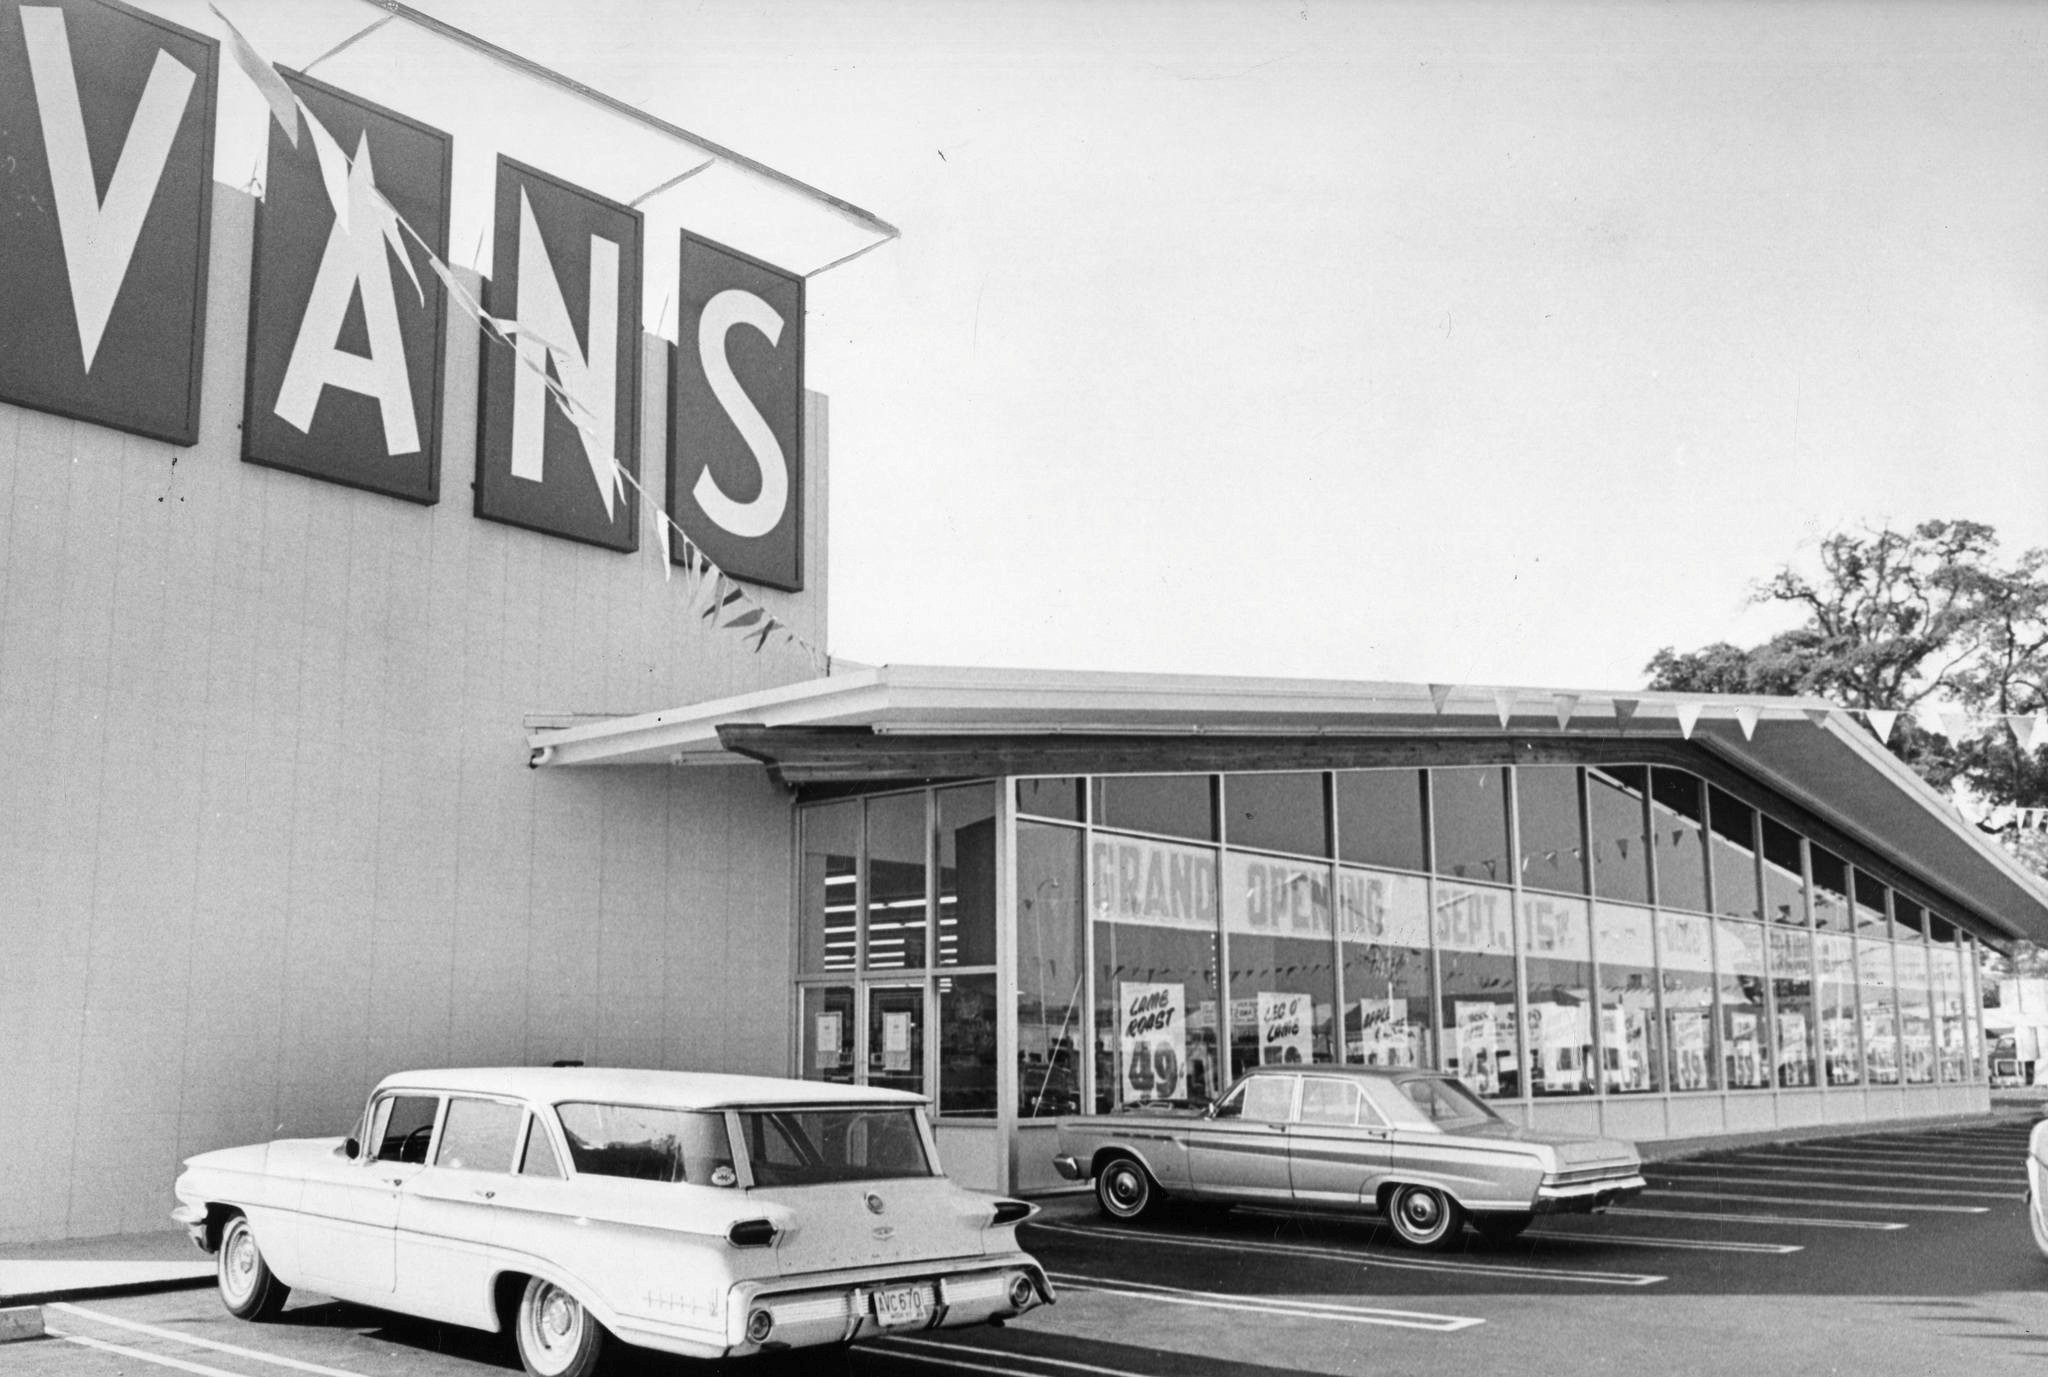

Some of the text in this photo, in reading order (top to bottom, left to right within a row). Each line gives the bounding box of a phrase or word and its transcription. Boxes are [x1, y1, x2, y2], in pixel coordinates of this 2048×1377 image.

[20, 6, 788, 538] VANS
[1093, 842, 1217, 921] GRAND
[1247, 863, 1384, 937] OPENING
[1125, 1007, 1175, 1039] ROAST
